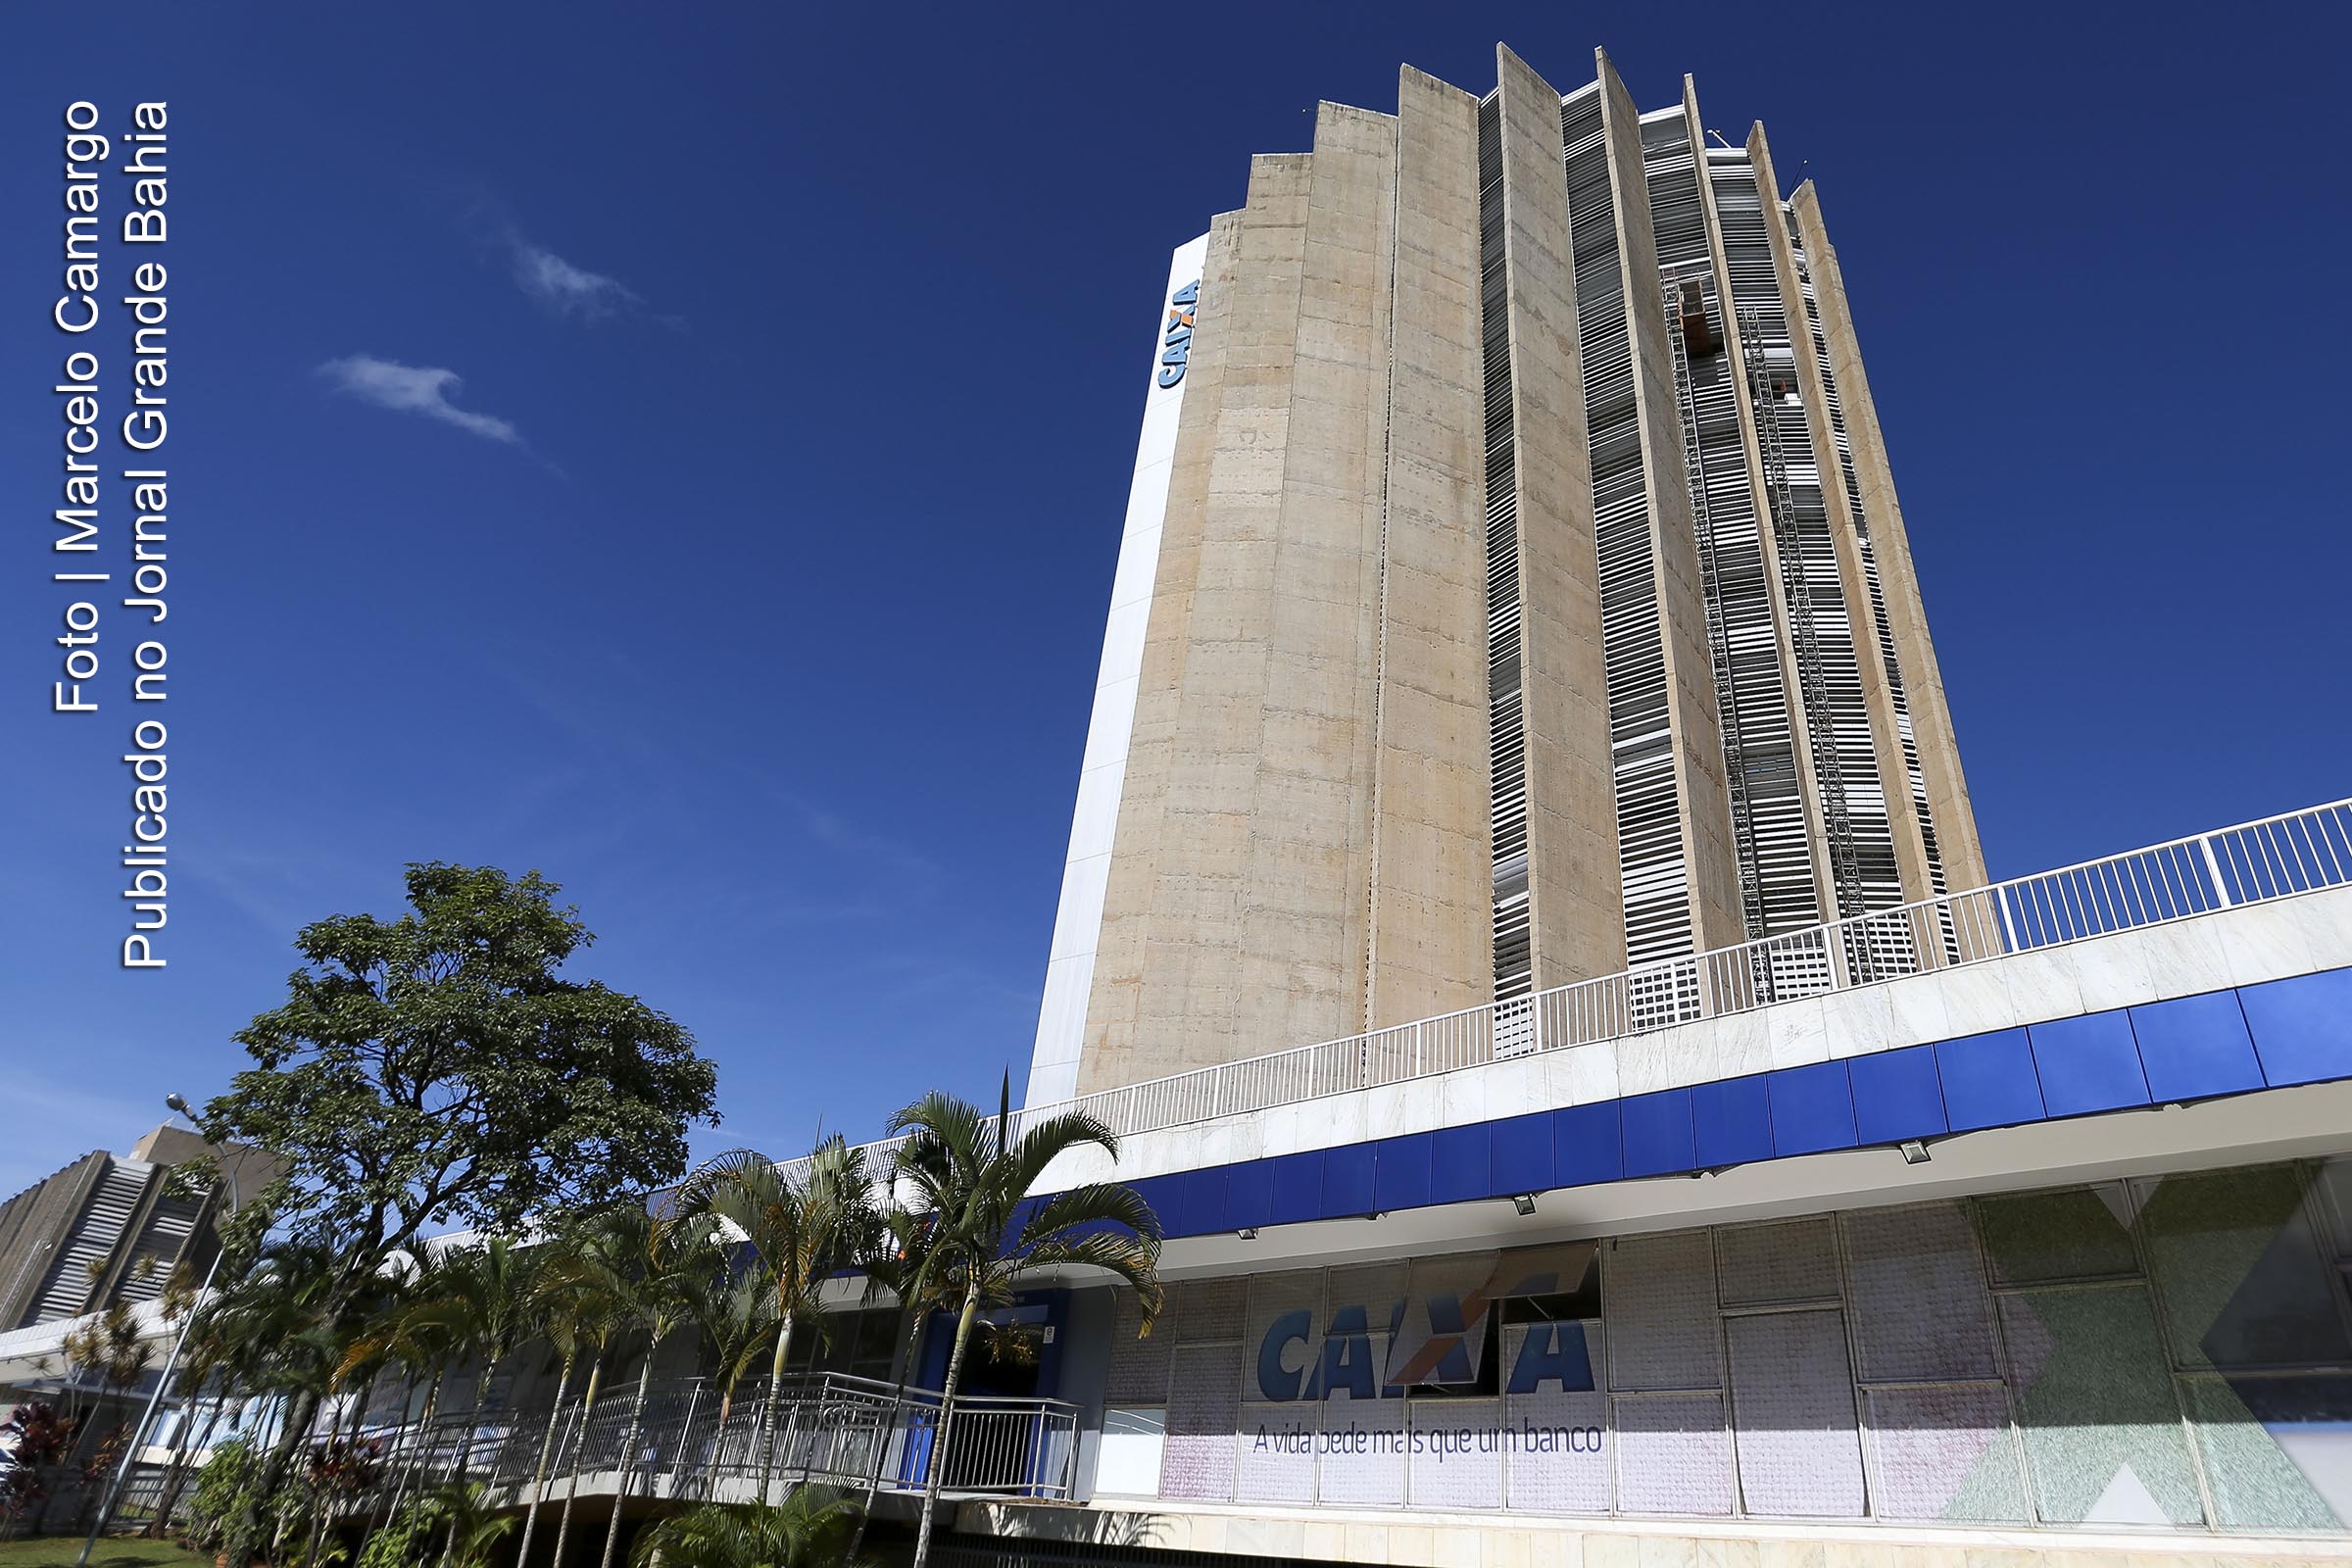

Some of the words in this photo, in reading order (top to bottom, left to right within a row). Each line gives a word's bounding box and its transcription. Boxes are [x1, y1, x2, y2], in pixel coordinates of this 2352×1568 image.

[1158, 278, 1200, 389] CAIXA
[1257, 1272, 1596, 1402] CAIXA
[1253, 1424, 1268, 1453] A
[1274, 1422, 1311, 1454] vida
[1373, 1420, 1424, 1454] mais
[1430, 1428, 1472, 1463] que
[1524, 1416, 1602, 1452] banco
